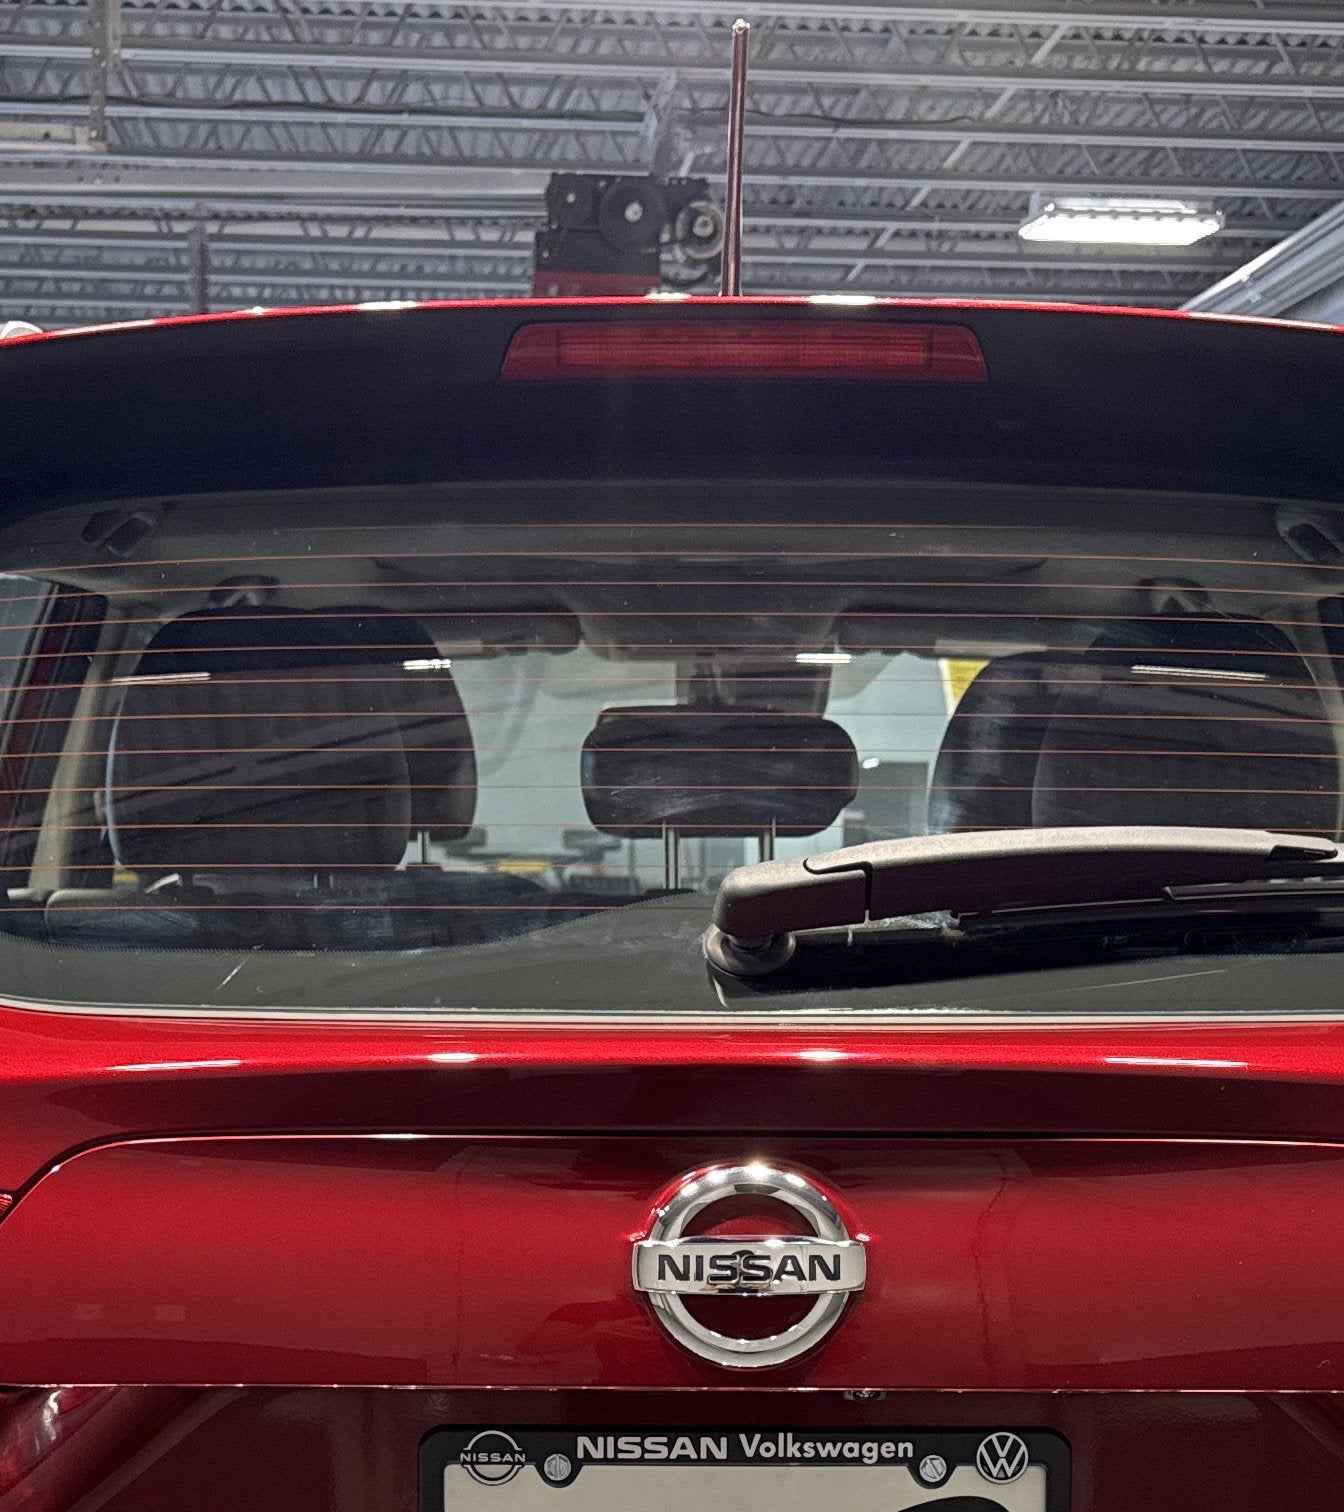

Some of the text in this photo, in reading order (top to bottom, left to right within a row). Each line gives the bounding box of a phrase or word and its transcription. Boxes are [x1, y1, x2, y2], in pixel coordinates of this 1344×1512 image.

[657, 1254, 841, 1282] NISSAN
[459, 1452, 526, 1463] NISSAN
[576, 1432, 914, 1464] NISSAN Volkswagen
